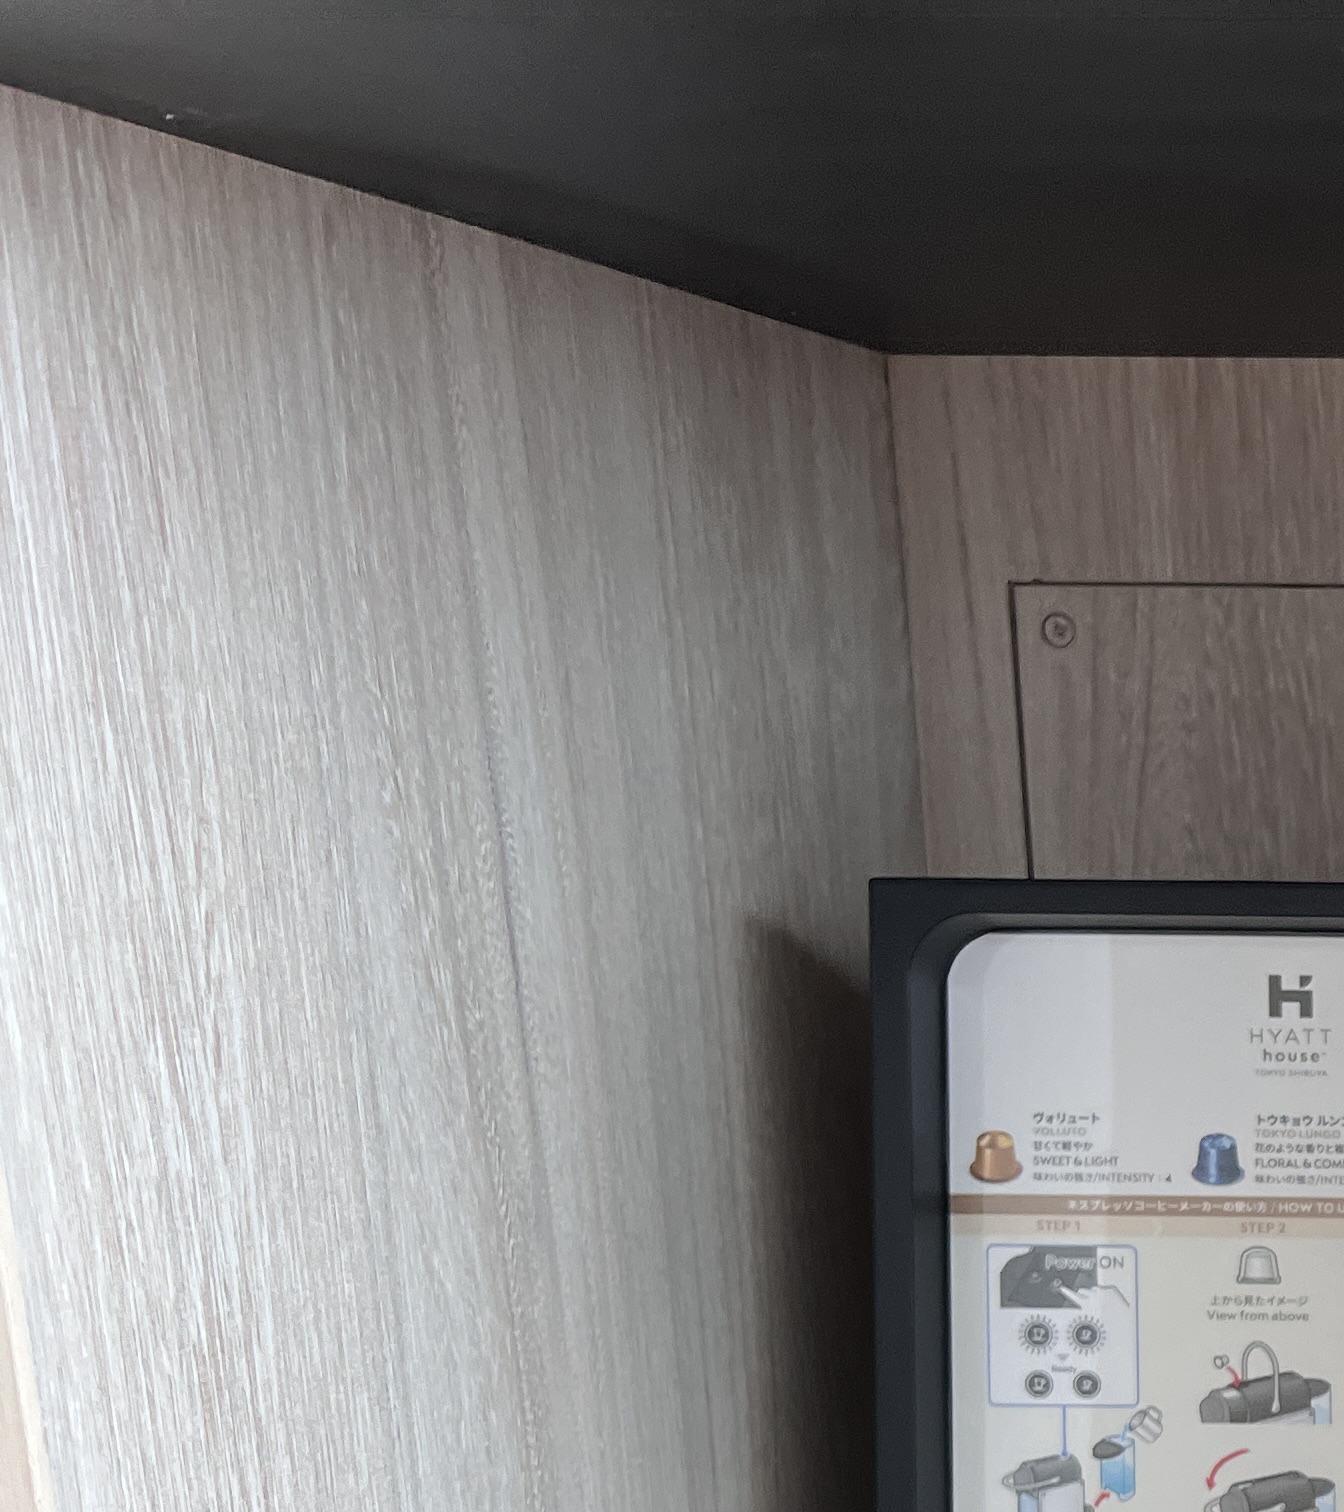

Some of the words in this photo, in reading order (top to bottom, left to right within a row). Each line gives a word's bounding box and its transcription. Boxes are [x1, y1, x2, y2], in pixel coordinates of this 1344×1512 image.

[1249, 1027, 1332, 1045] HYATT
[1033, 1112, 1100, 1124] ヴォリュート
[1257, 1114, 1314, 1127] トウキョウ
[1255, 1129, 1297, 1139] TOKYO
[1033, 1156, 1071, 1166] SWEET
[1084, 1156, 1119, 1167] LIGHT
[1255, 1158, 1299, 1169] FLORAL
[1302, 1158, 1312, 1169] &
[1279, 1203, 1312, 1213] HOW
[1317, 1203, 1335, 1214] TO
[1036, 1220, 1070, 1231] STEP
[1240, 1222, 1274, 1233] STEP
[1045, 1254, 1096, 1271] Power
[1100, 1256, 1124, 1269] ON
[1207, 1310, 1237, 1320] View
[1240, 1310, 1269, 1320] from
[1272, 1311, 1310, 1321] above
